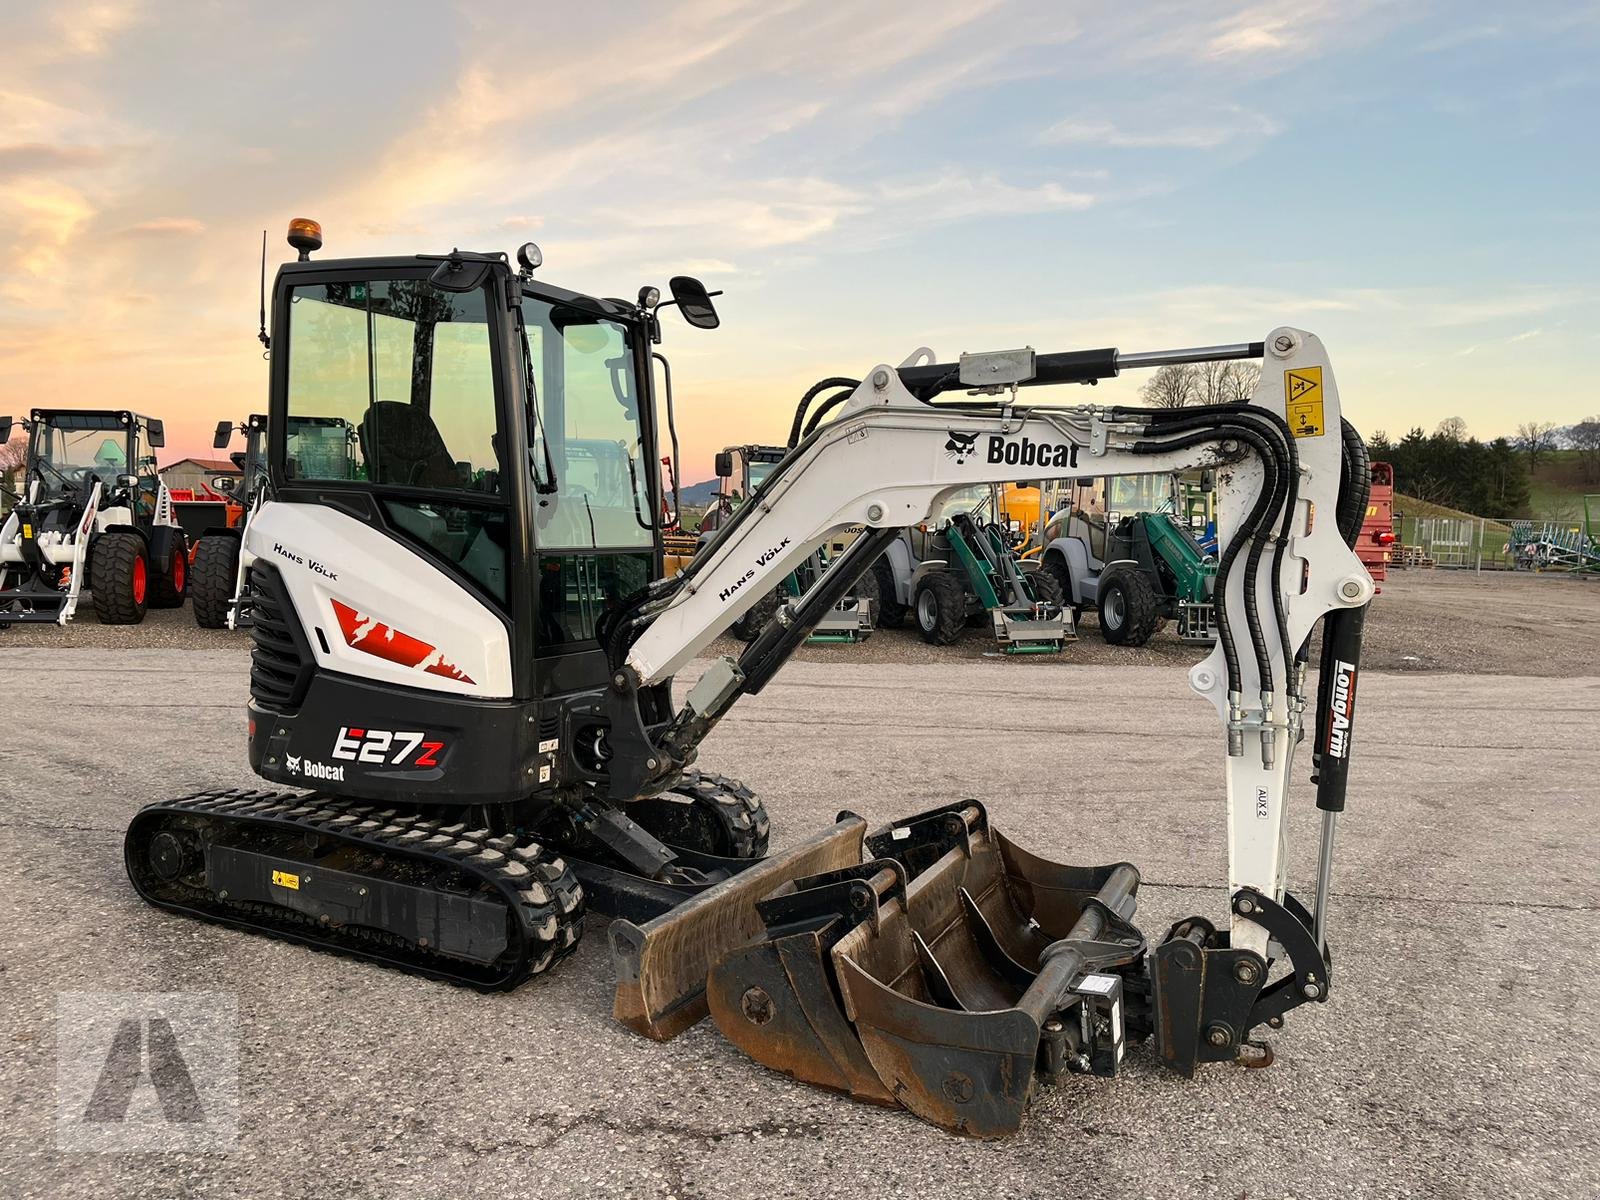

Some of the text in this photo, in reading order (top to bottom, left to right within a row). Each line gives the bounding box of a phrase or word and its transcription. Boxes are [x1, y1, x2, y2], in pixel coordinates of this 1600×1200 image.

[988, 436, 1079, 468] Bobcat
[273, 543, 339, 582] HANS VÖLK
[718, 535, 792, 602] HANS VÖLK
[1329, 661, 1355, 758] LongArm
[304, 759, 345, 782] Bobcat
[1258, 789, 1267, 808] AUX
